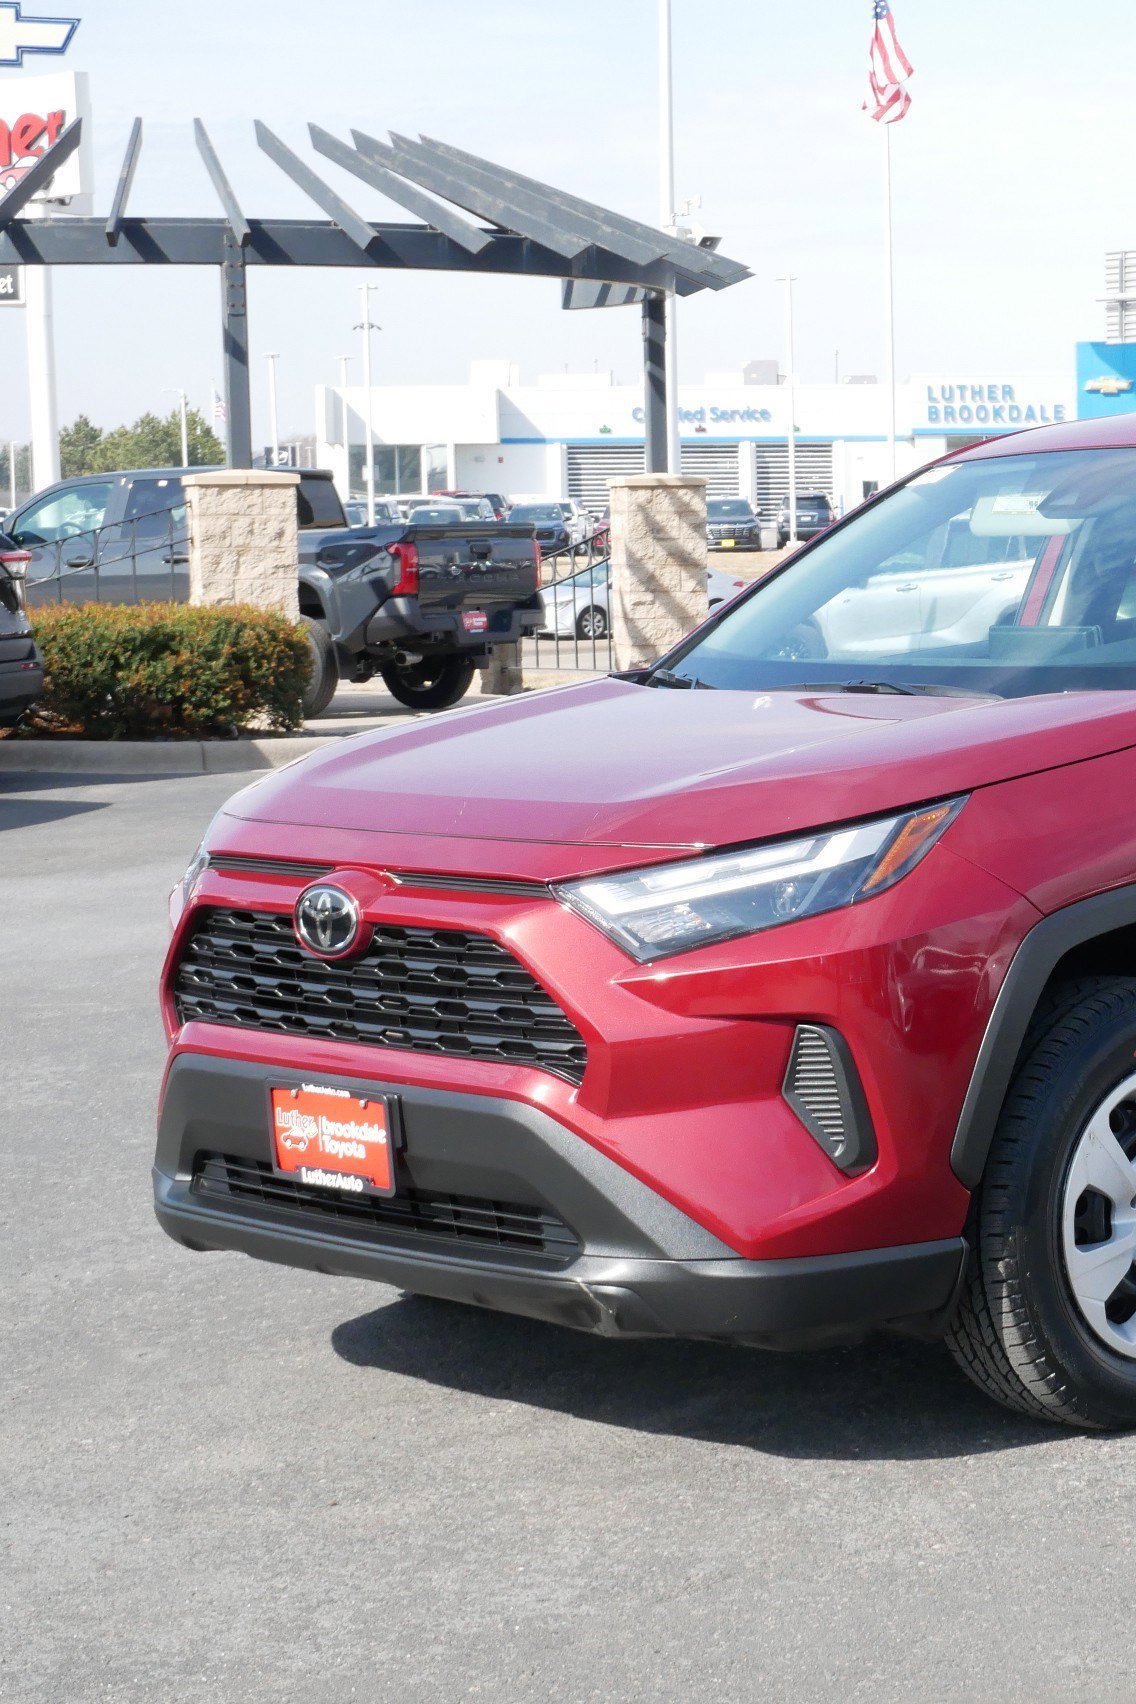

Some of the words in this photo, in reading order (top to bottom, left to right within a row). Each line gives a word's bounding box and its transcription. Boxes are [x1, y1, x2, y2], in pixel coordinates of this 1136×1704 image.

[927, 384, 1016, 403] LUTHER
[709, 406, 772, 423] Service
[928, 404, 1066, 424] BROOKDALE
[322, 1135, 366, 1159] Toyota
